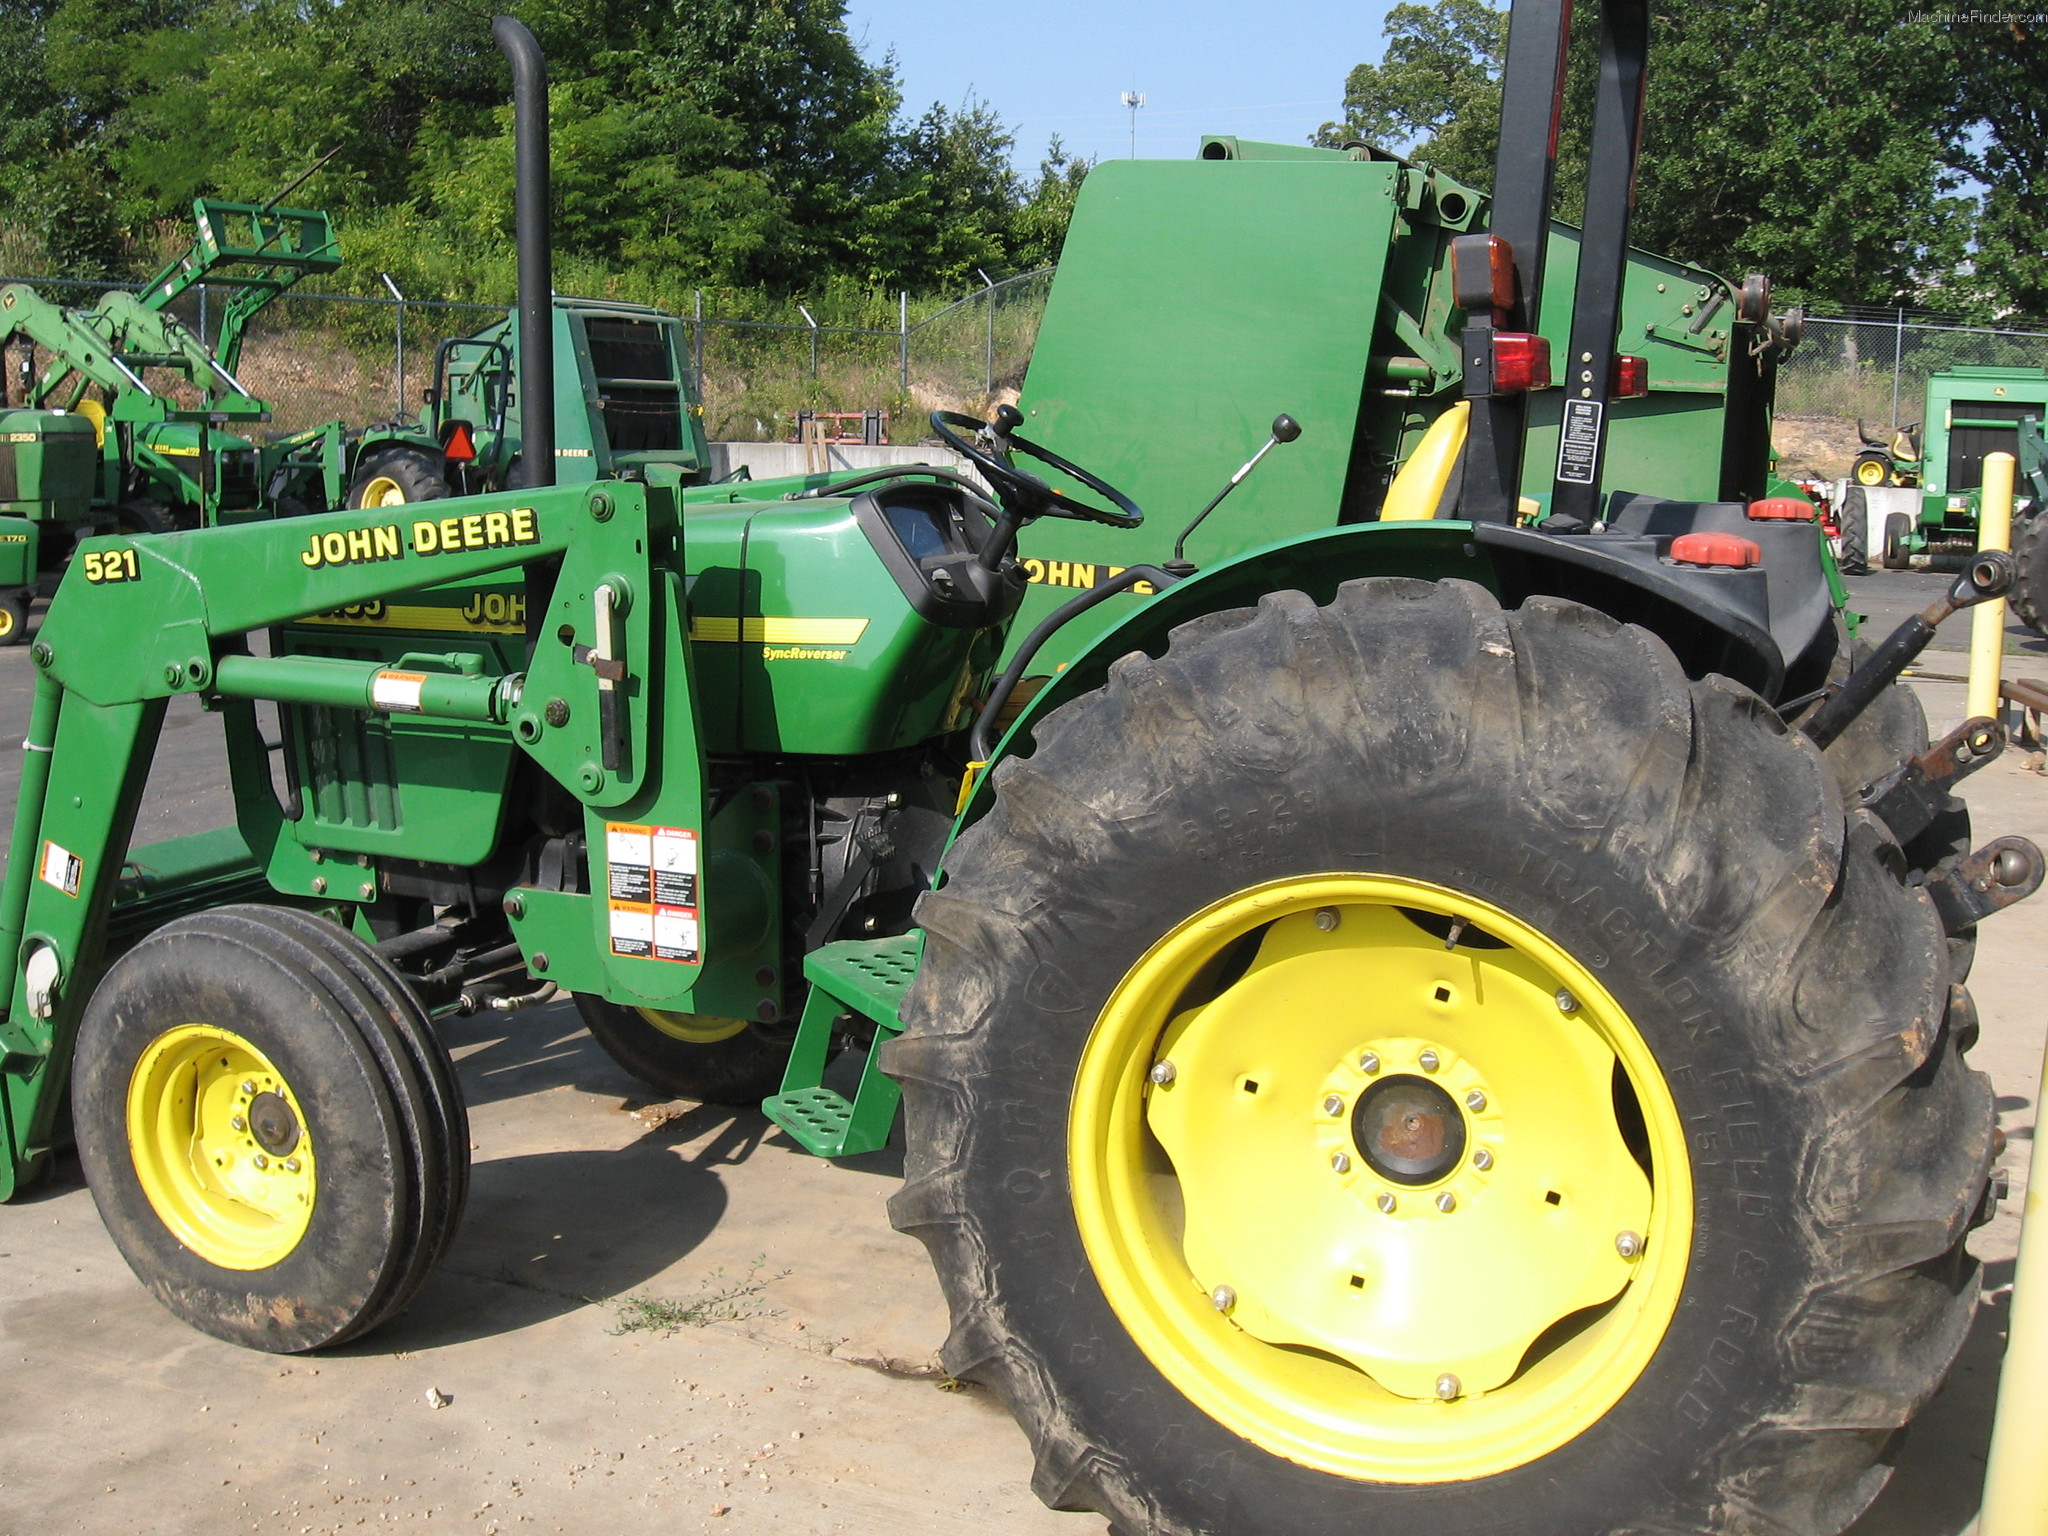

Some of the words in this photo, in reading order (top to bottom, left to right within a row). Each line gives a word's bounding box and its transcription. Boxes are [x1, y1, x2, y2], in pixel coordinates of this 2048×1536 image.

[83, 548, 140, 584] 521
[301, 525, 403, 568] JOHN
[411, 507, 541, 555] DEERE
[1015, 557, 1096, 589] OHN
[1519, 842, 1724, 1044] TRACTION
[1709, 1066, 1774, 1217] FIELD
[1675, 1304, 1759, 1431] ROAD
